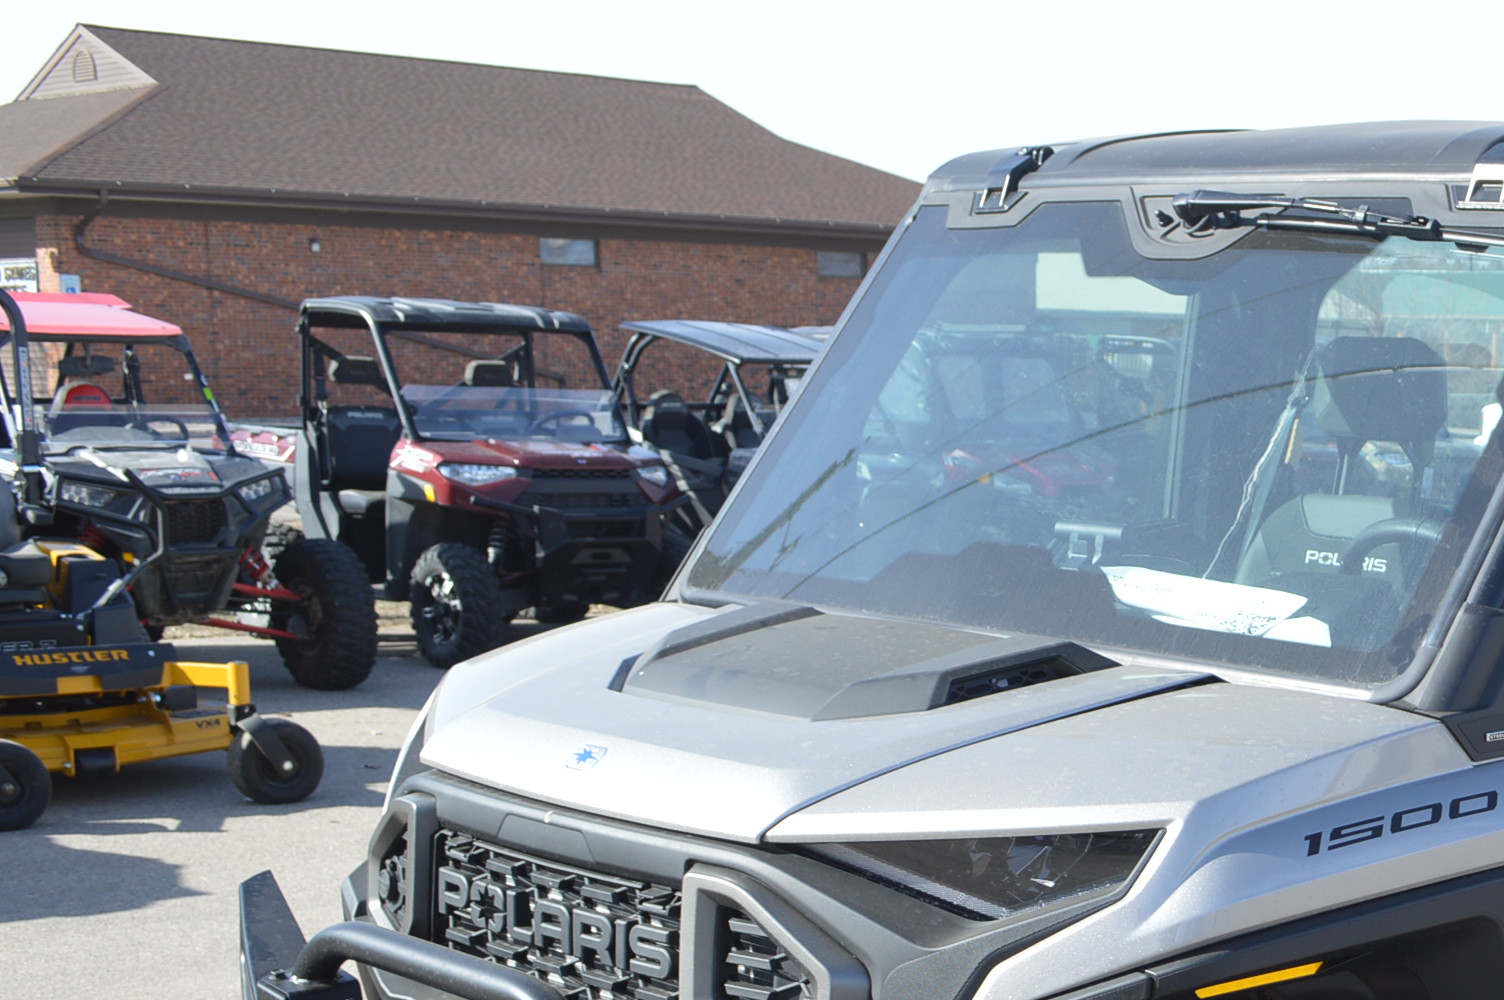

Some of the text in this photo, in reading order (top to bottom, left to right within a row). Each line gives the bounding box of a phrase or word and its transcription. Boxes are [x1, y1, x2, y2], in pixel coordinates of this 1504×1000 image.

[12, 649, 130, 666] HUSTLER
[195, 718, 221, 729] VX4
[1304, 790, 1498, 857] 1500
[438, 866, 677, 979] POLARIS
